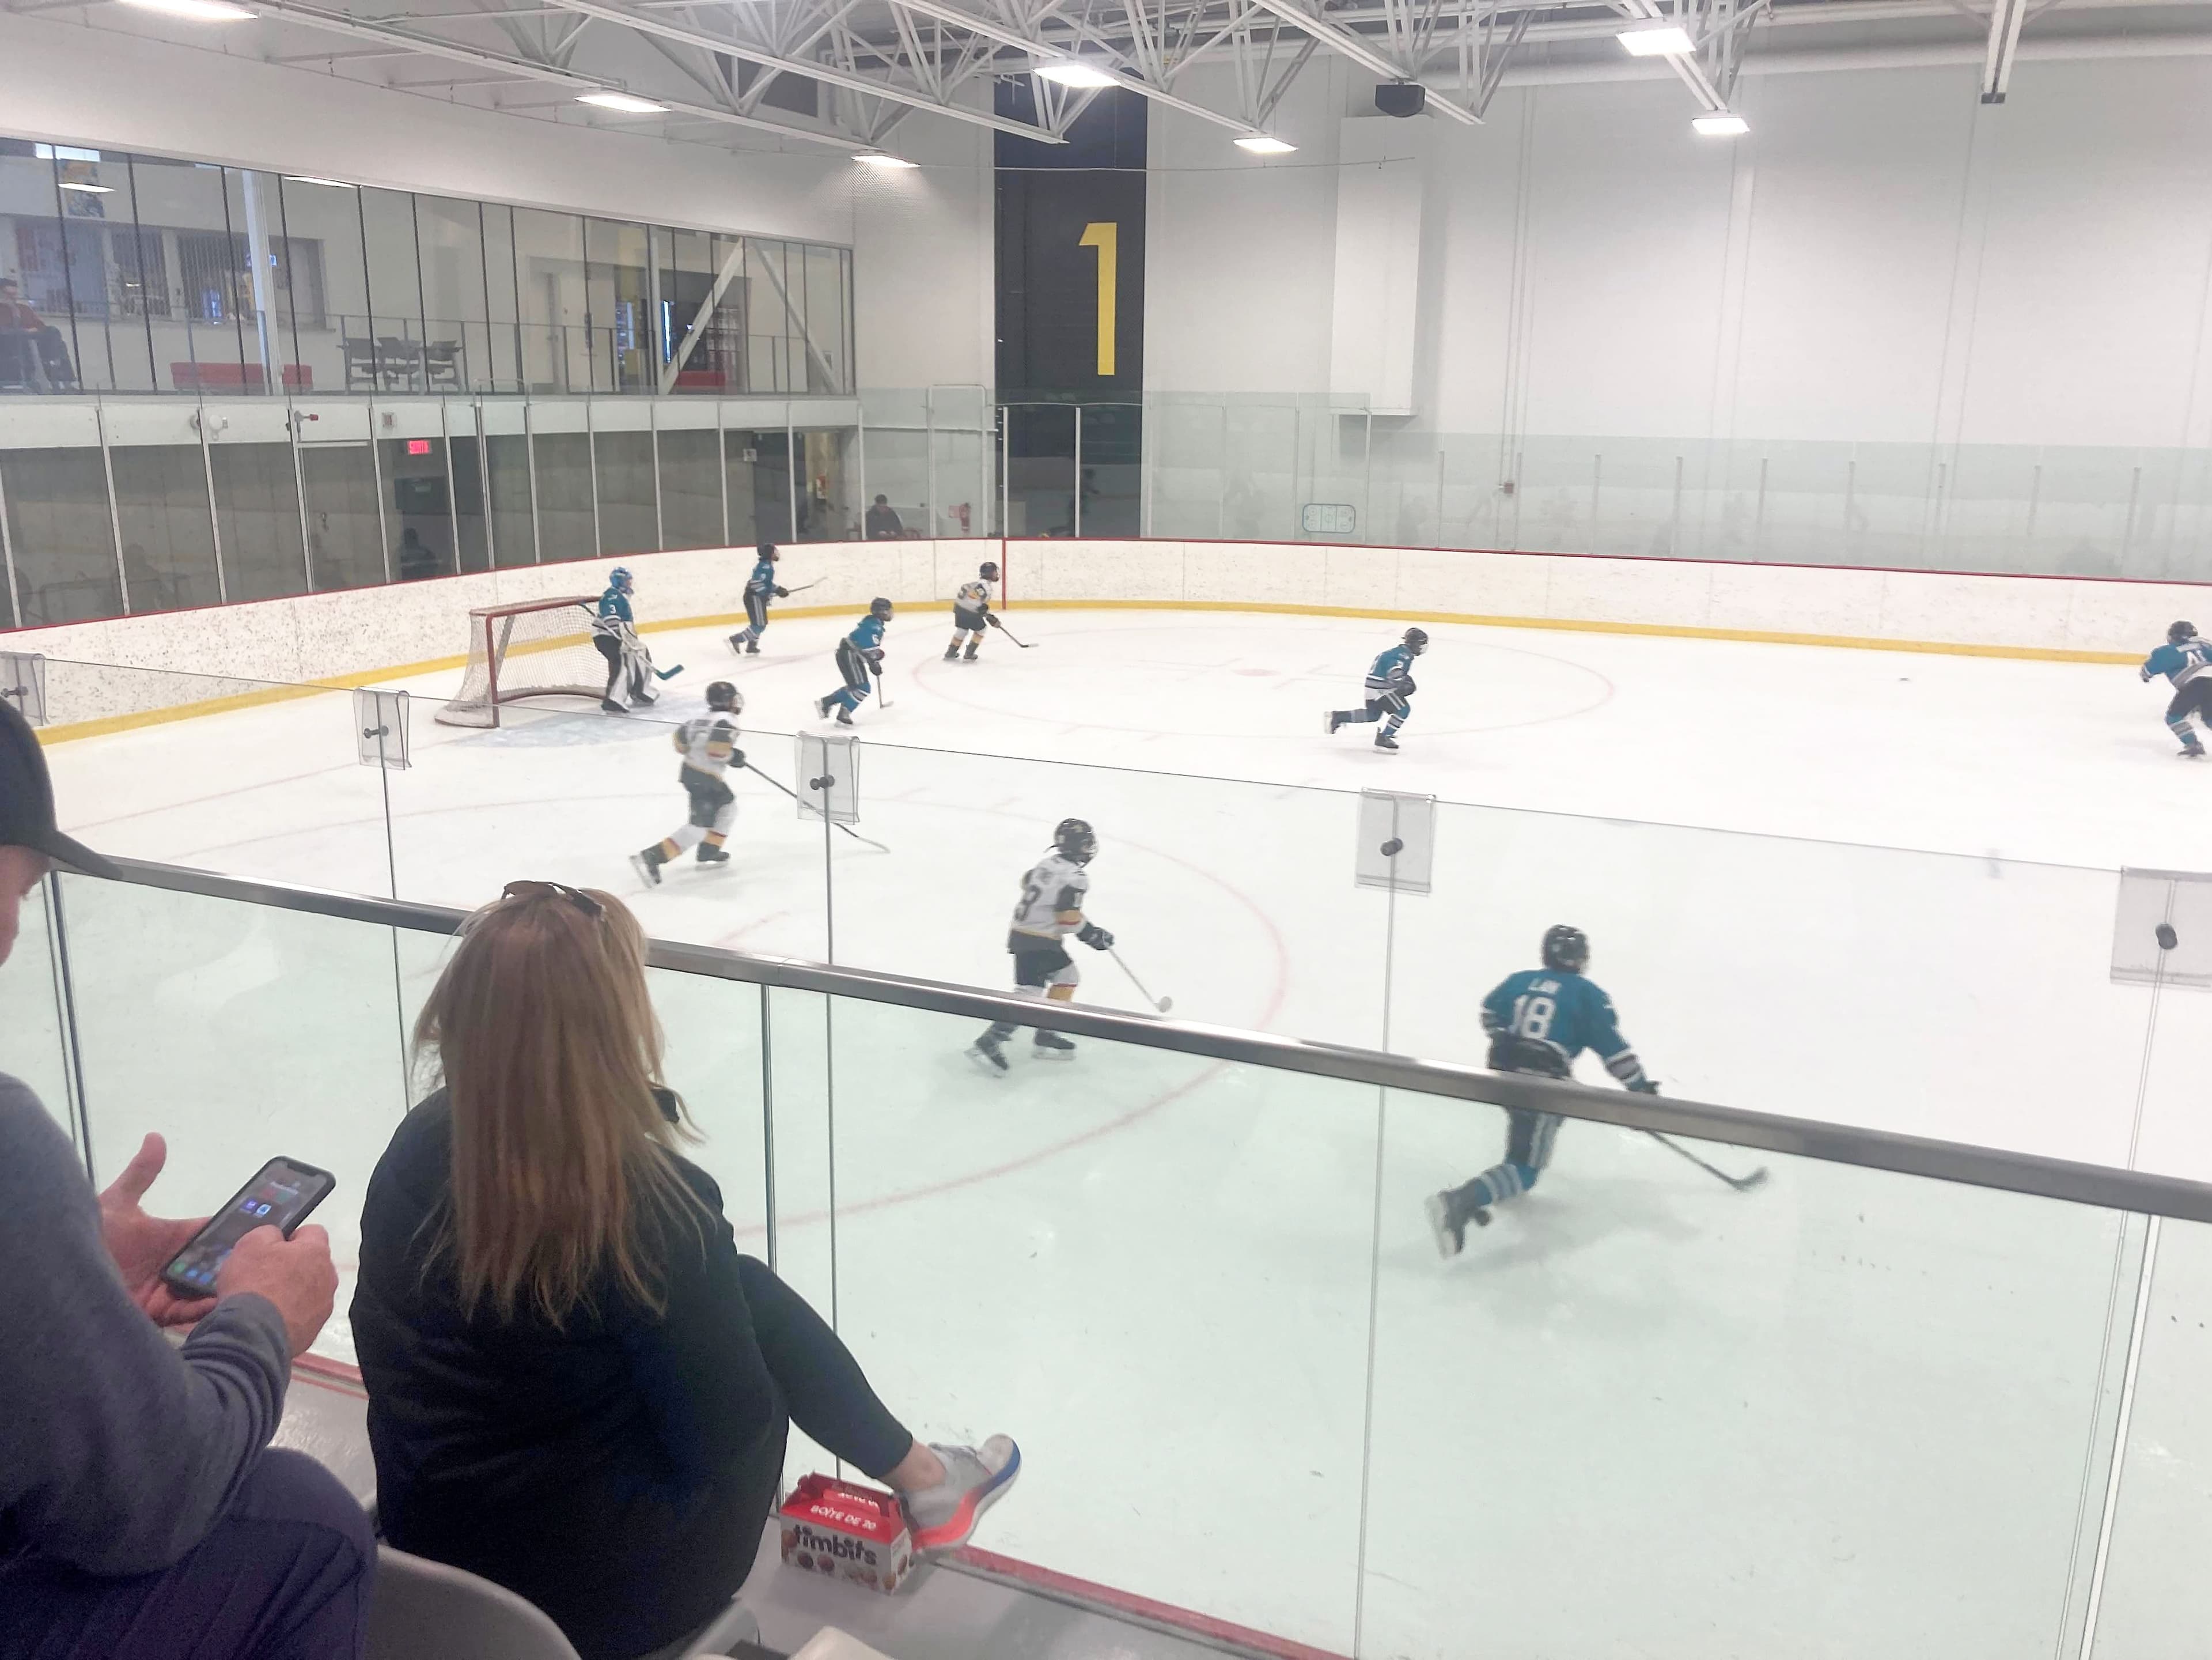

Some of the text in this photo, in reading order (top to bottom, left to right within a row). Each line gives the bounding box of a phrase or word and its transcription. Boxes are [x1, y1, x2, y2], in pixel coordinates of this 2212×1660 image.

[1079, 222, 1118, 375] 1
[1508, 994, 1556, 1038] 18
[844, 1514, 861, 1526] DE
[794, 1524, 877, 1566] timbits
